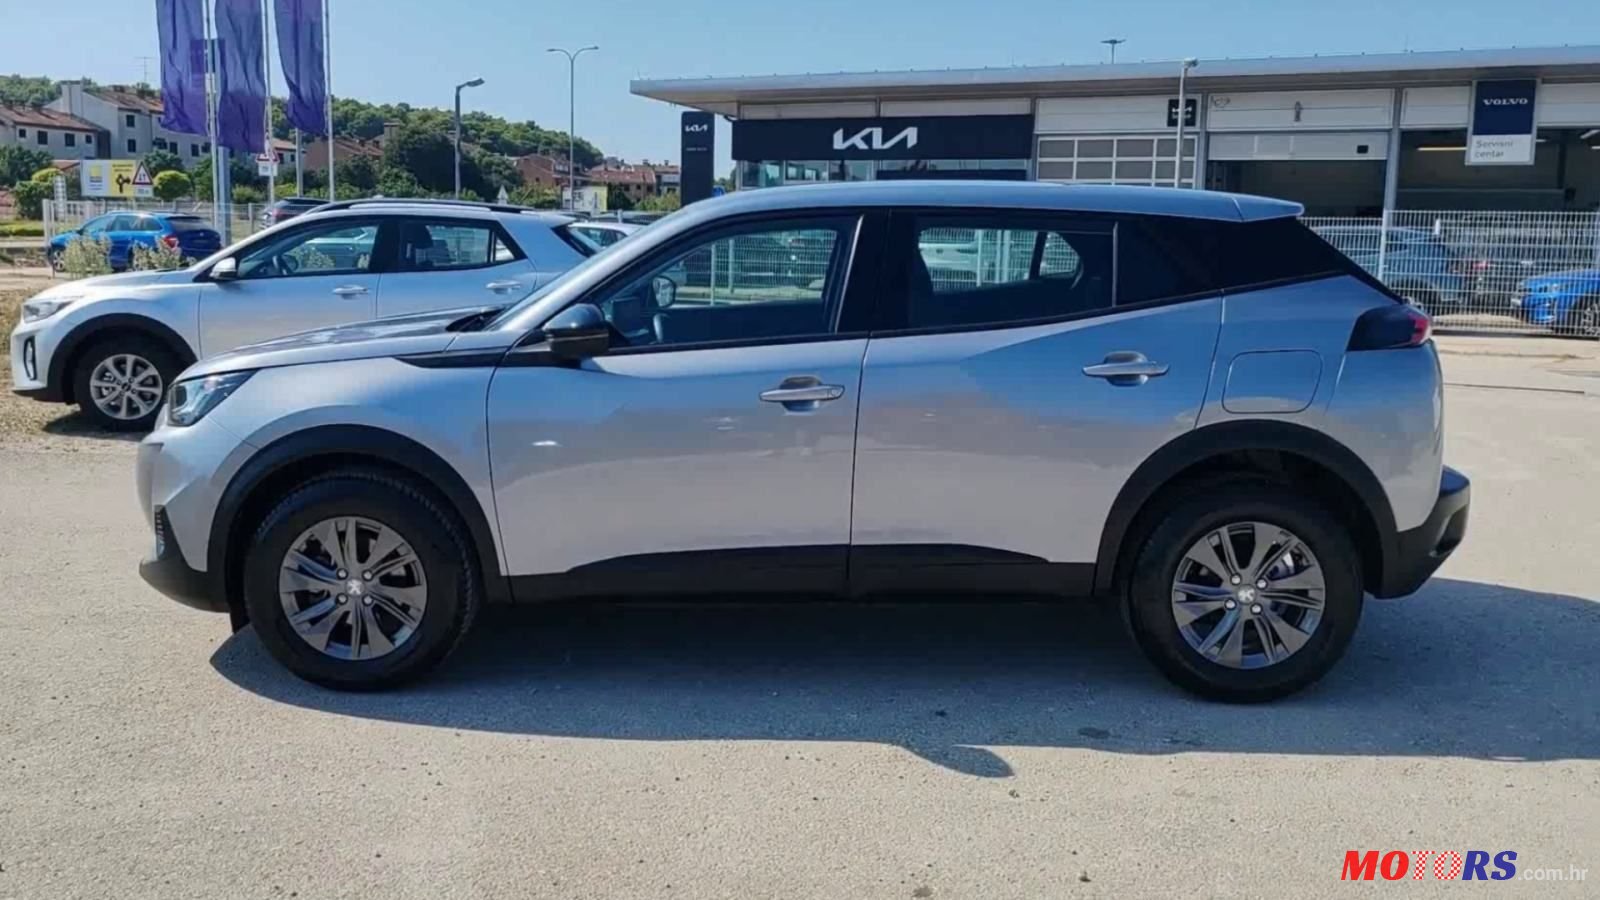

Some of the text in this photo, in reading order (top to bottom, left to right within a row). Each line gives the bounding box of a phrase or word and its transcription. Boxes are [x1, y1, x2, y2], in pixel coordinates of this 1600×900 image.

[1483, 98, 1528, 106] VOLVO
[685, 124, 708, 132] KIA
[833, 127, 918, 150] KIA
